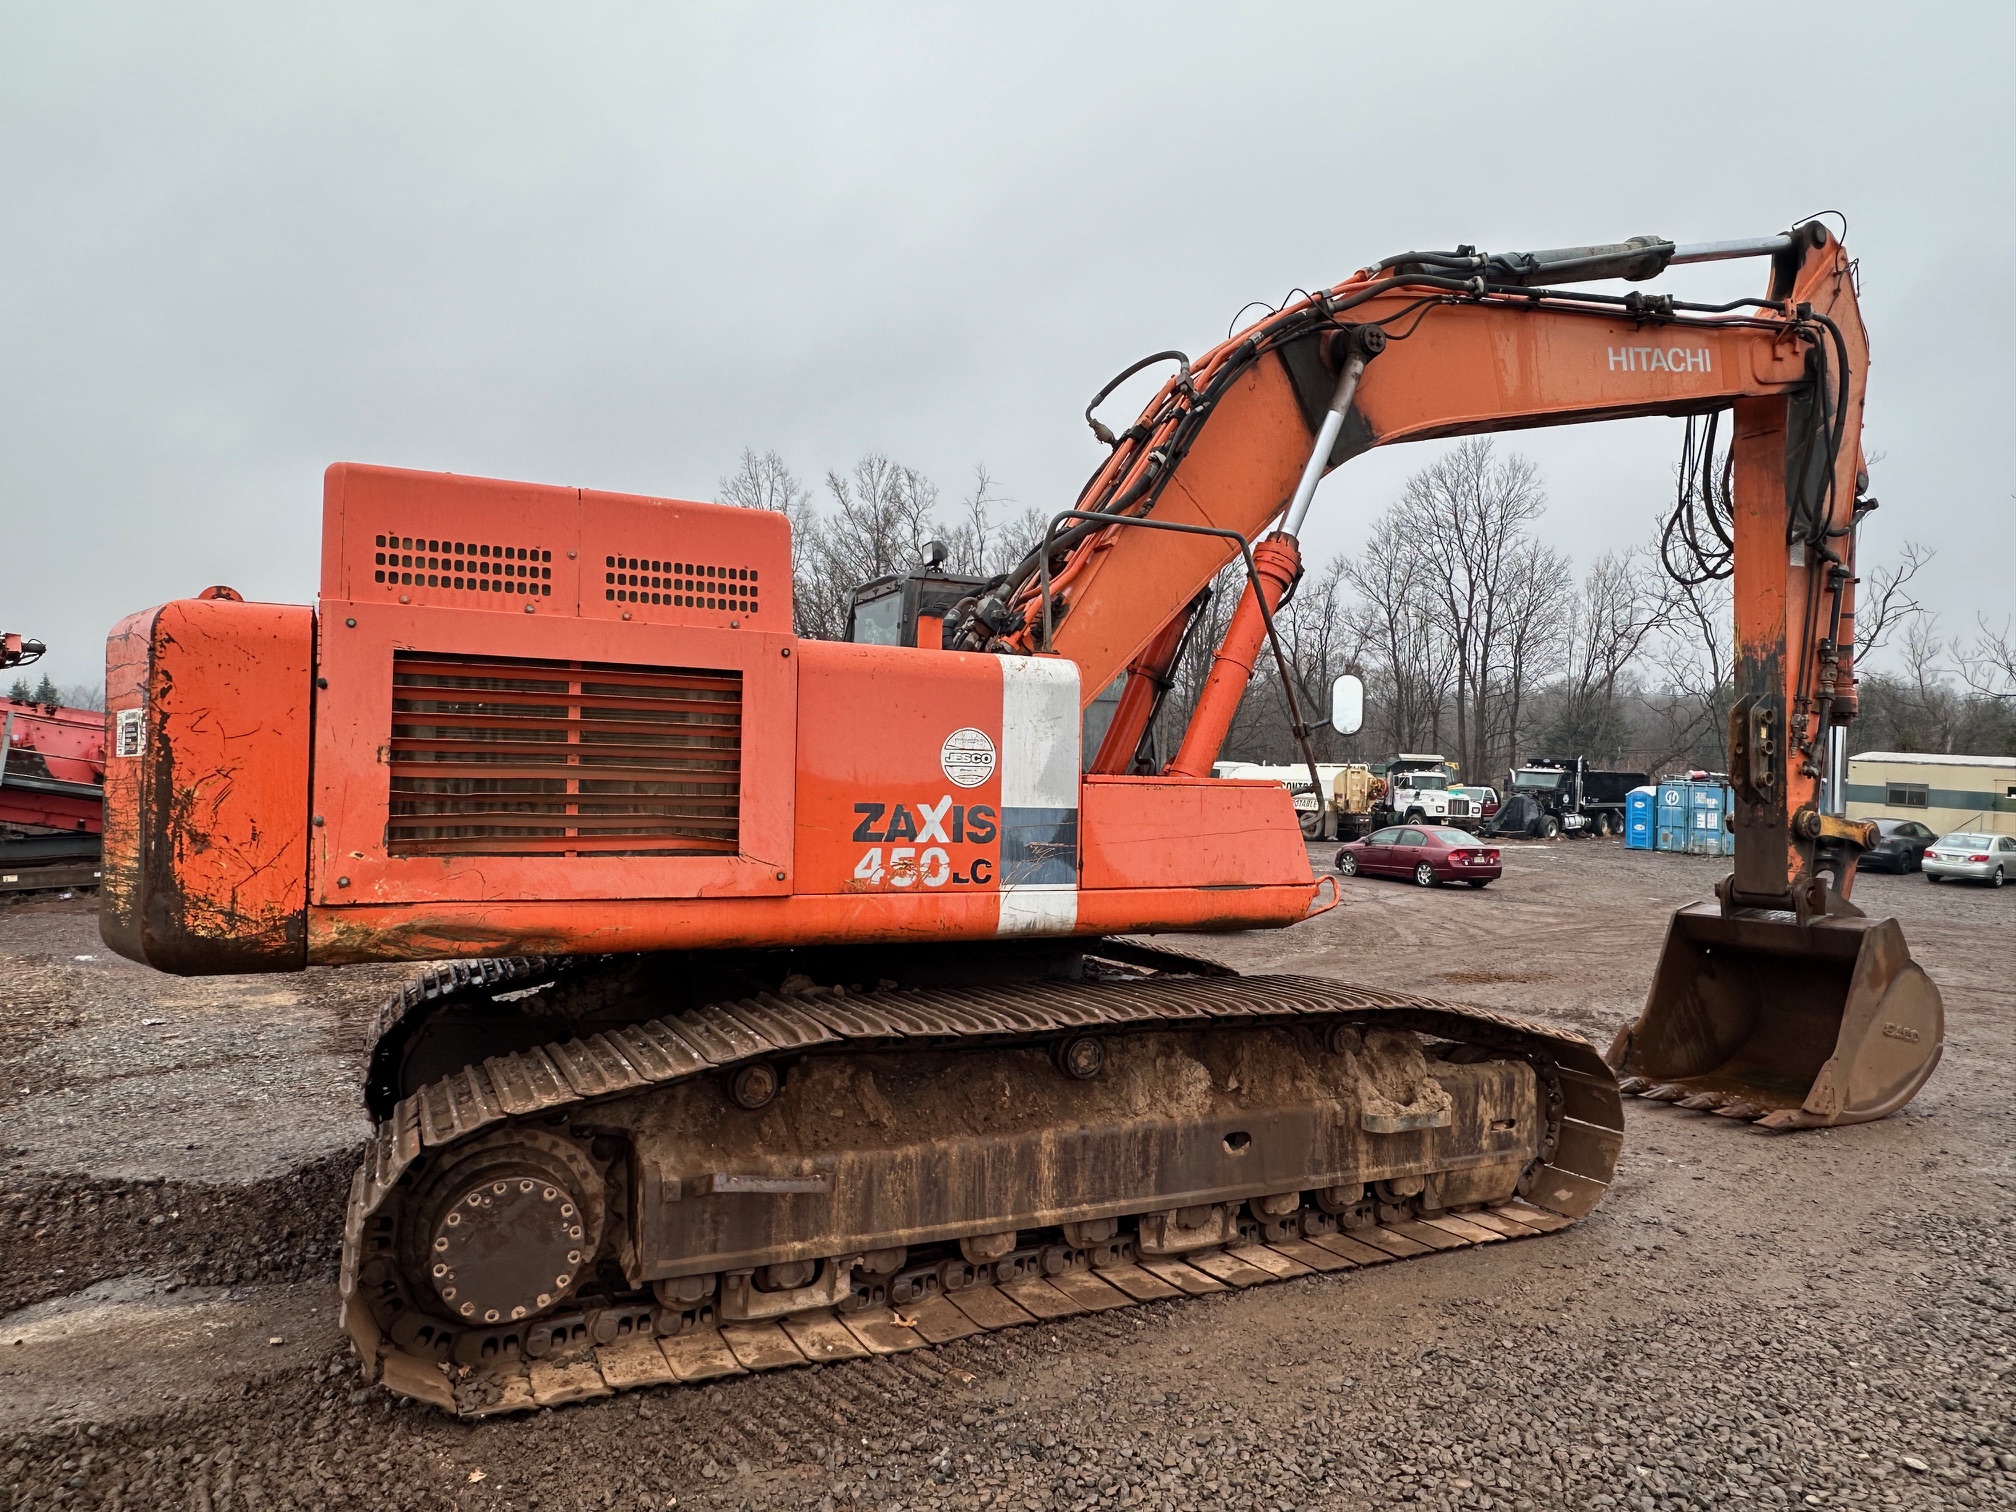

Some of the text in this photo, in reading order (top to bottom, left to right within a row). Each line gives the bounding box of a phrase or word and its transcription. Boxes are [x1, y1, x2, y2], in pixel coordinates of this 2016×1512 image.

[1608, 346, 1711, 373] HITACHI
[945, 753, 992, 764] JESCO
[853, 794, 997, 844] ZAXIS
